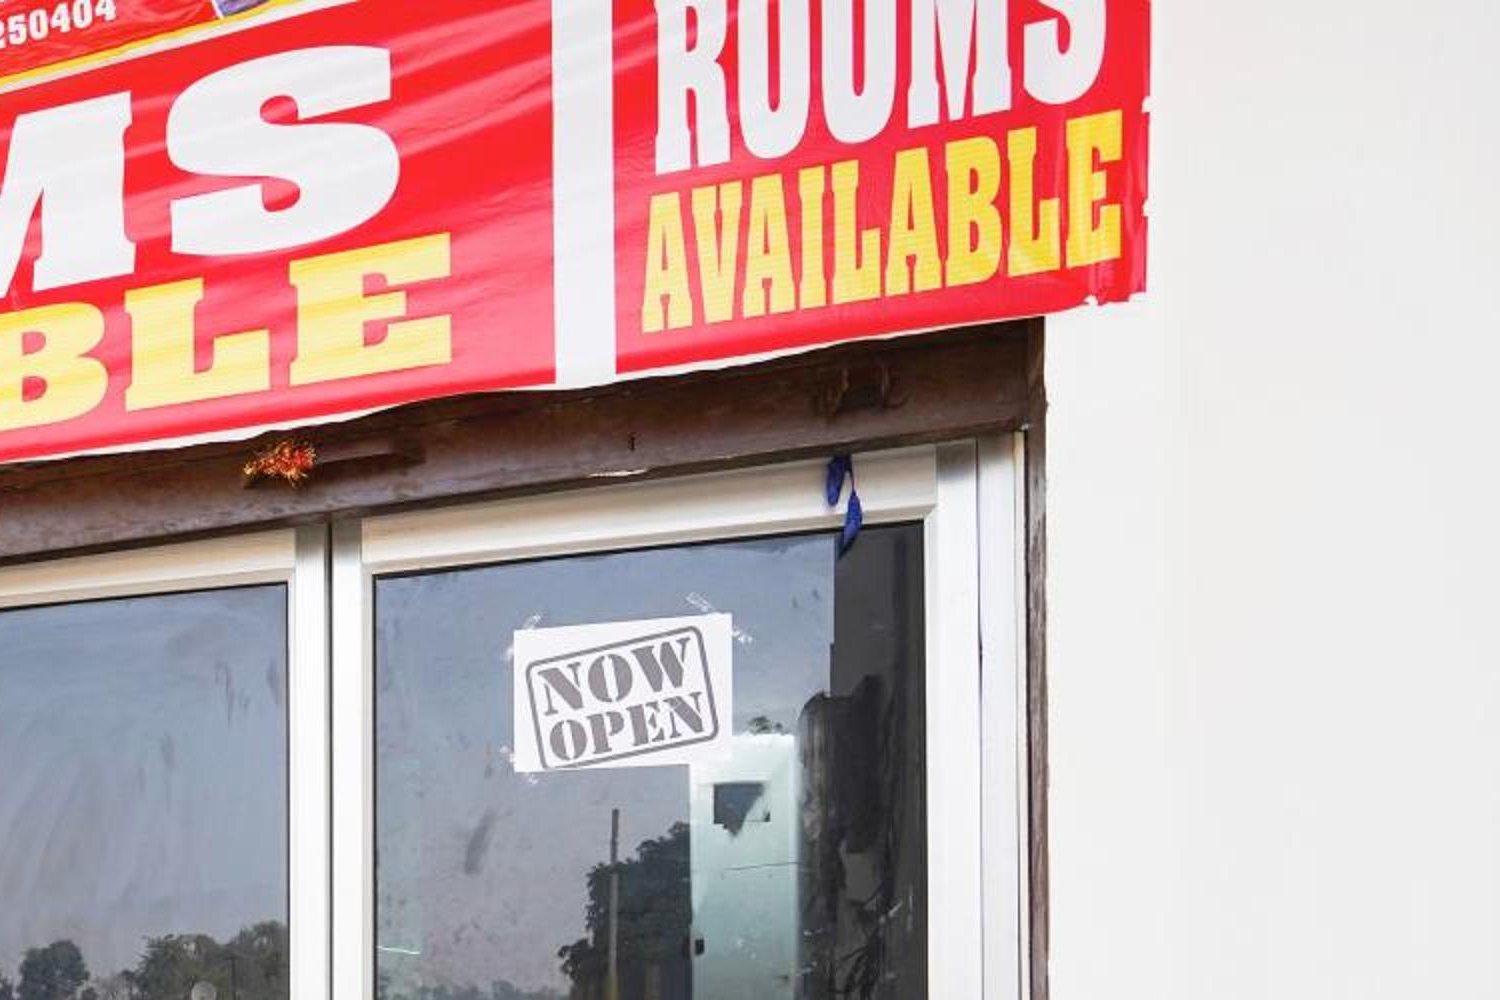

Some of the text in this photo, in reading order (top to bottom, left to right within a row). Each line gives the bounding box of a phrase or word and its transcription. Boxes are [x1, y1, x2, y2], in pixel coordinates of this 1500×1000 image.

[642, 110, 1122, 333] AVAILABLE
[537, 637, 691, 717] NOW
[549, 691, 704, 762] OPEN
